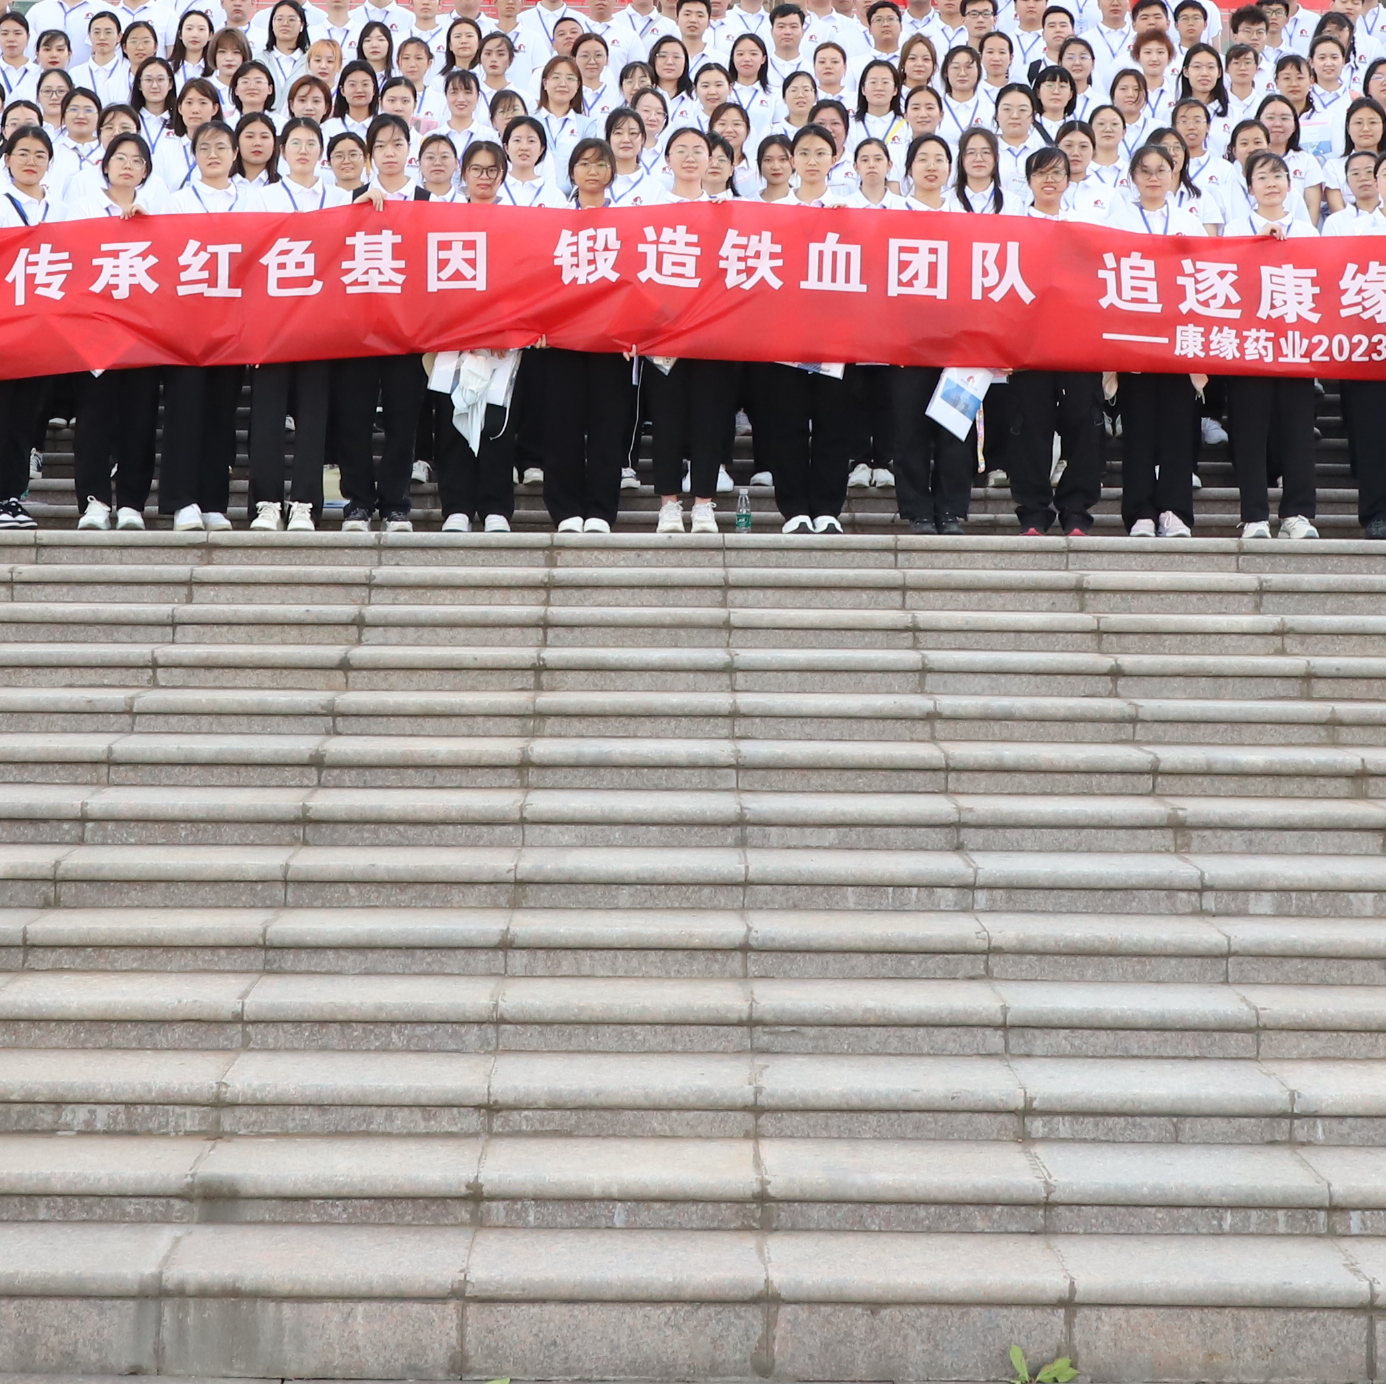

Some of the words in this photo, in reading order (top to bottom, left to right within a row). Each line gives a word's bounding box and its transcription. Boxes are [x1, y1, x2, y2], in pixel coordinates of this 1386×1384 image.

[4, 229, 488, 307] 传承红色基因
[553, 225, 1037, 306] 锻造铁血团队
